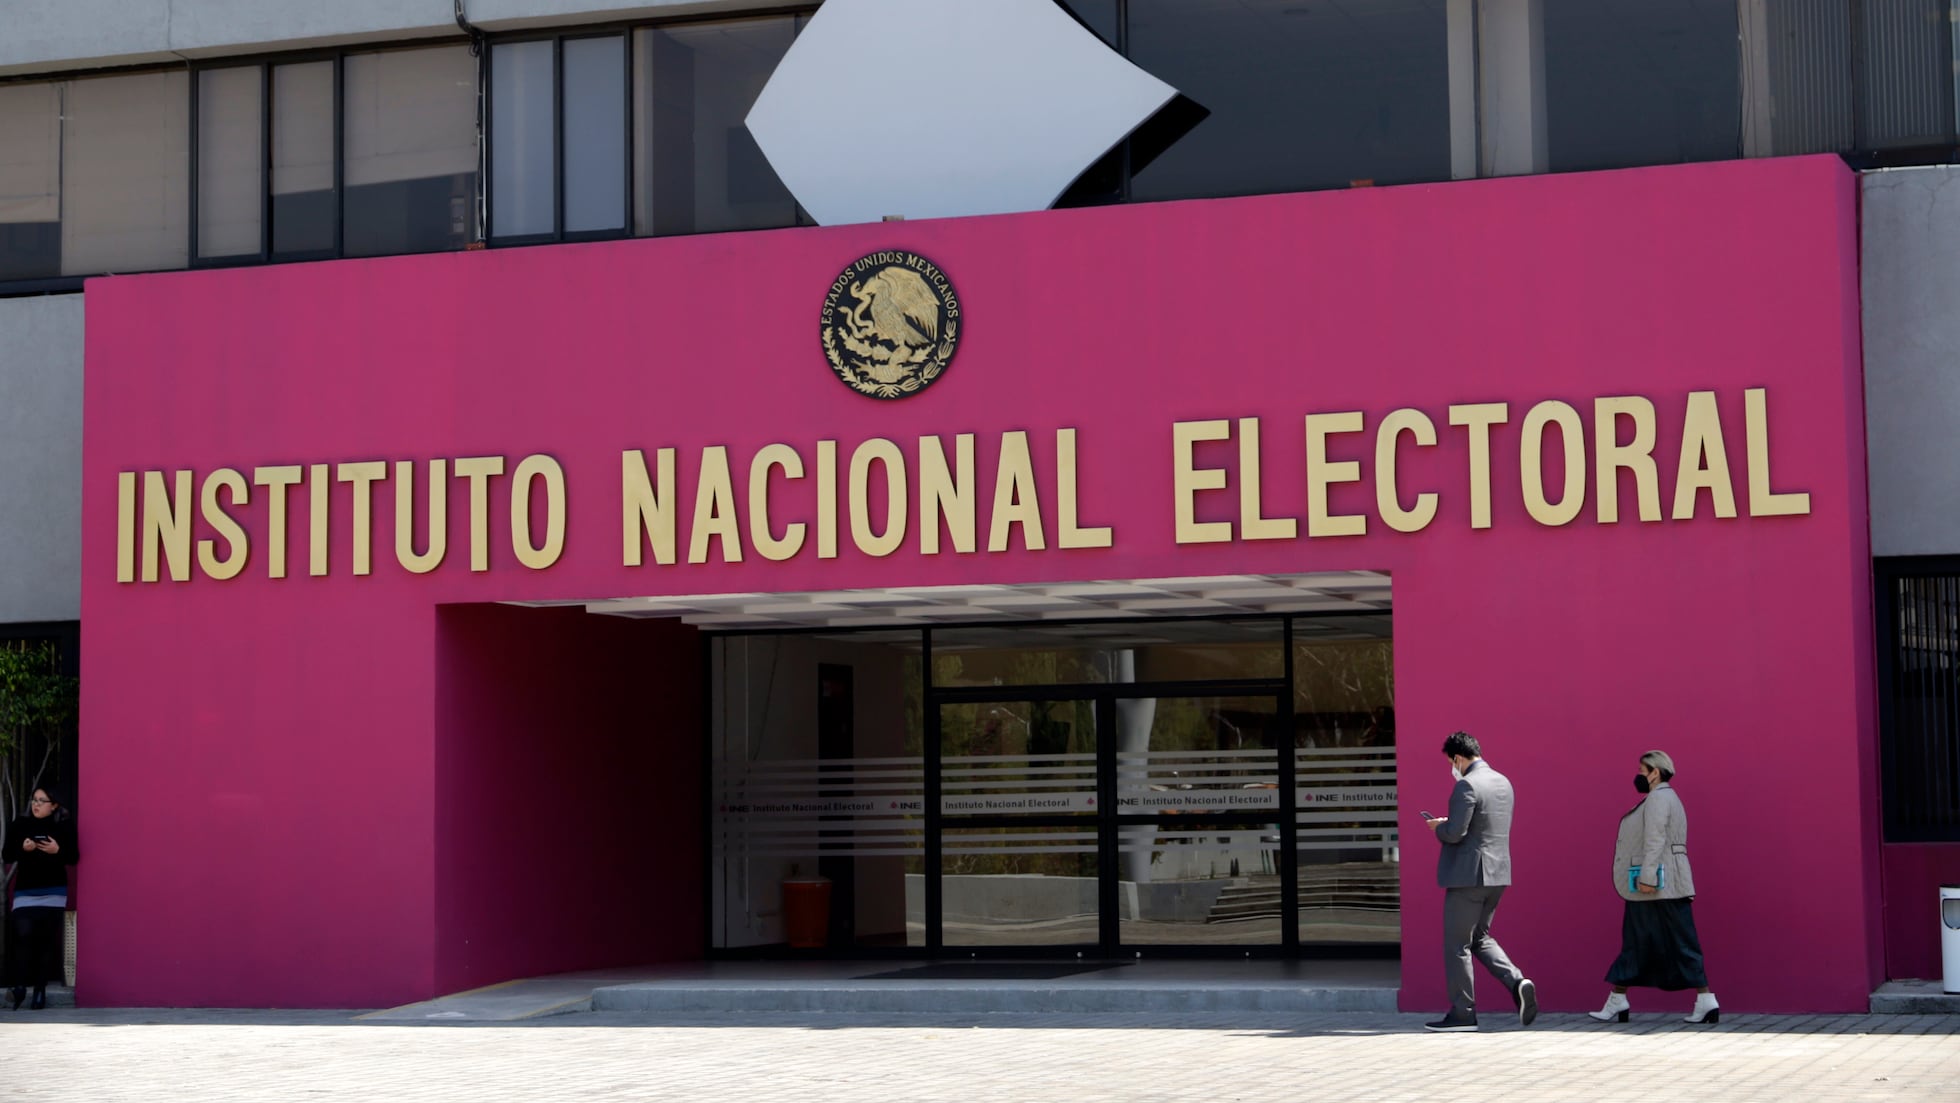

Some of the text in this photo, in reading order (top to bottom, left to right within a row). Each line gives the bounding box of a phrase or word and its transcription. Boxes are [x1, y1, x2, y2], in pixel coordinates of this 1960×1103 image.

[821, 251, 959, 325] ESTADOS UNIDOS MEXICANOS
[116, 387, 1811, 584] INSTITUTO NACIONAL ELECTORAL
[1143, 797, 1183, 806] Instituto
[1184, 796, 1226, 805] Nacional
[1228, 795, 1272, 804] Electoral
[1315, 794, 1339, 802] INE
[1342, 793, 1384, 802] Instituto
[729, 802, 874, 813] INE Instituto Nacional Electoral
[900, 798, 1070, 810] INE Instituto Nacional Electoral
